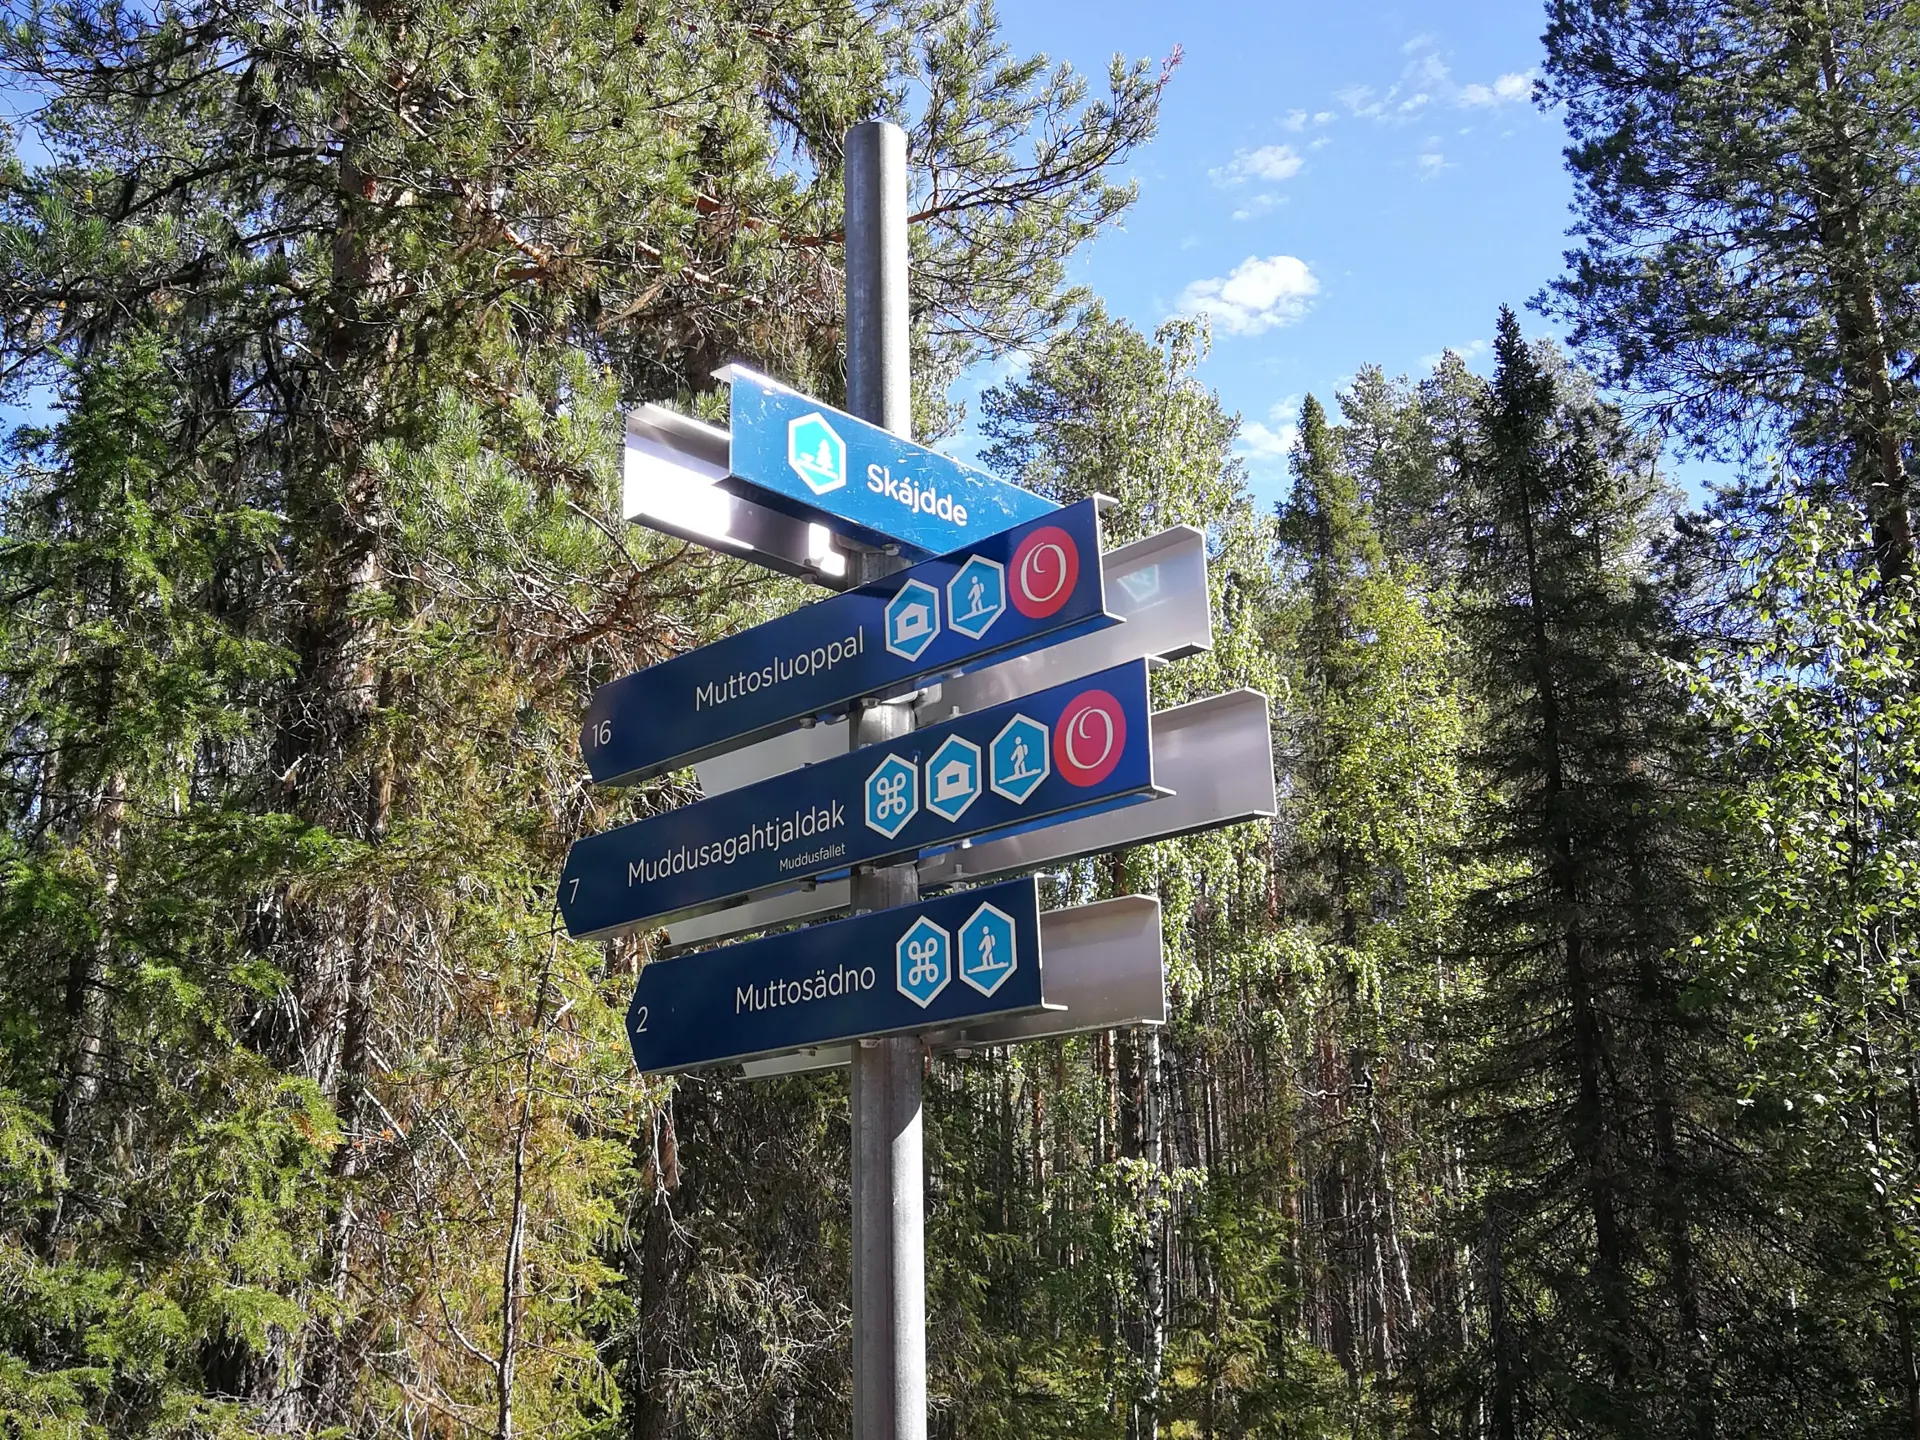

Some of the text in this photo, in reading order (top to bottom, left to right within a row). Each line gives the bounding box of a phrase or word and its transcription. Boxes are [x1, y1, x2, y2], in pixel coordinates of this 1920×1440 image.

[867, 463, 968, 527] Skájdde
[591, 625, 864, 748] 16 Muttosluoppal
[568, 799, 845, 904] 7 Muddusagahtjaldak
[779, 842, 846, 872] Muddusfallet
[635, 964, 876, 1033] 2 Muttosädno
